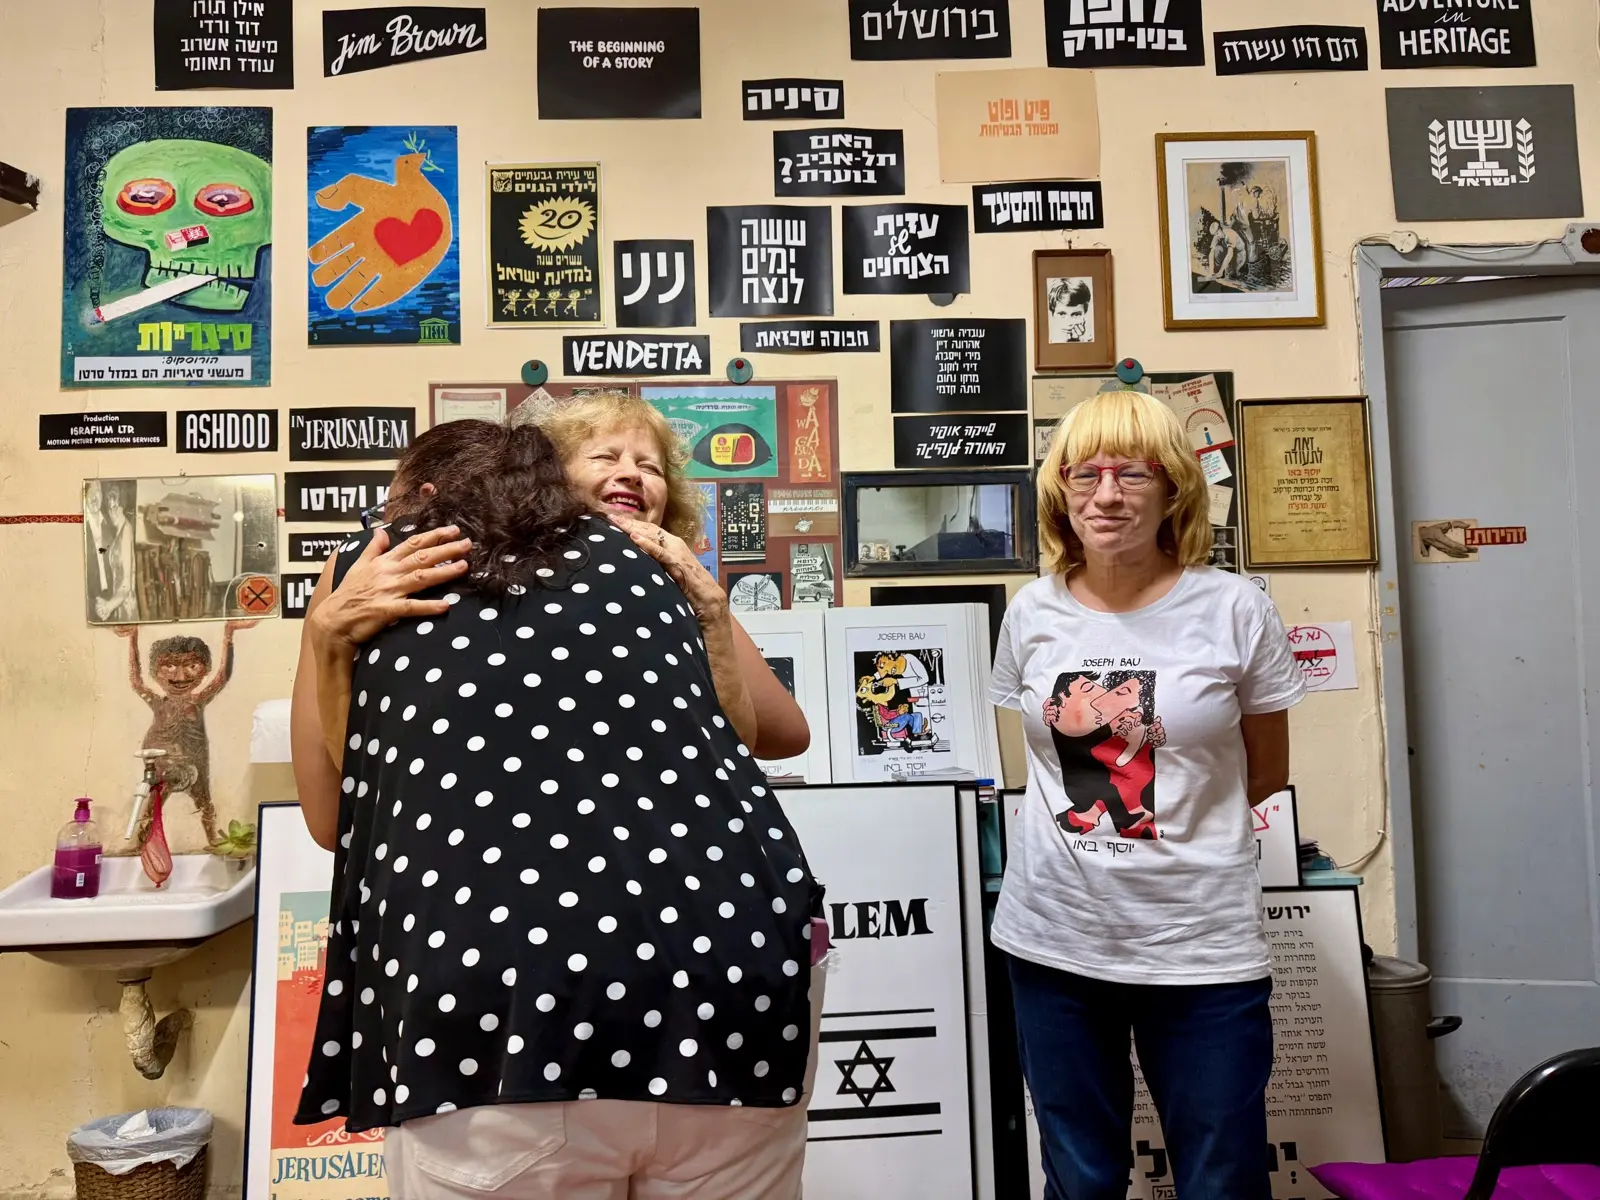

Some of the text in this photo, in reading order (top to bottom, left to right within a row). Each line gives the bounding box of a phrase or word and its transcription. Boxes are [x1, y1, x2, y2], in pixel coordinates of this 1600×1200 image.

[234, 1, 264, 18] אילן
[1434, 9, 1471, 23] in
[200, 20, 260, 35] דוד ורדי
[862, 1, 999, 41] בירושלים
[181, 38, 278, 53] מישה אשרוב
[331, 15, 484, 75] Jim Brown
[569, 40, 665, 53] THE BEGINNING
[1063, 27, 1187, 57] בניו-יורק
[1399, 27, 1511, 56] HERITAGE
[1222, 36, 1359, 63] הם היו עשרה
[185, 57, 274, 72] עודד תאומי
[583, 56, 654, 69] OF A STORY
[747, 87, 839, 111] סיניה
[809, 134, 873, 149] האם
[796, 150, 897, 167] תל-אביב
[515, 171, 552, 181] גבעתיים
[583, 170, 595, 180] שי
[1452, 174, 1516, 187] ישראל
[515, 181, 597, 193] לילדי הגנים
[982, 190, 1094, 226] תרבח ותסעד
[537, 209, 582, 230] 20
[874, 212, 939, 239] עזית
[741, 218, 807, 246] ששה
[537, 255, 582, 266] עשרים שנה
[742, 247, 795, 275] ימים
[863, 252, 949, 280] הצנחנים
[497, 263, 593, 286] למדינת ישראל
[742, 268, 804, 304] לנצח
[137, 321, 253, 351] סיגריות
[755, 330, 869, 348] חבורה שכזאת
[931, 328, 985, 338] עובדיה גרשוני
[951, 340, 980, 350] אהרונה
[571, 340, 702, 373] VENDETTA
[965, 351, 981, 360] מירי
[78, 366, 244, 380] מעשני סיגריות הם במזל סרטן
[963, 363, 977, 372] דידי
[960, 374, 979, 384] מרקו
[936, 385, 956, 395] קדמי
[83, 414, 120, 422] Production
[70, 425, 114, 436] ISRAFILM
[185, 413, 271, 450] ASHDOD
[291, 415, 409, 450] IN JERUSALEM
[964, 442, 1007, 455] המורה
[1291, 437, 1315, 452] זאת
[1284, 447, 1323, 466] לתעודה
[301, 540, 342, 556] יניים
[877, 632, 926, 641] JOSEPH BAU
[1287, 626, 1321, 644] נא לא
[1081, 657, 1141, 668] JOSEPH BAU
[1073, 840, 1135, 857] יוסף באו
[1263, 905, 1311, 920] ירוש
[828, 898, 934, 949] LEM
[1275, 978, 1287, 987] של
[1296, 1002, 1322, 1012] ישראל
[1280, 1029, 1302, 1038] אותה
[1285, 1054, 1313, 1063] ישראל
[1271, 1082, 1284, 1090] את
[1285, 1079, 1305, 1089] גבול
